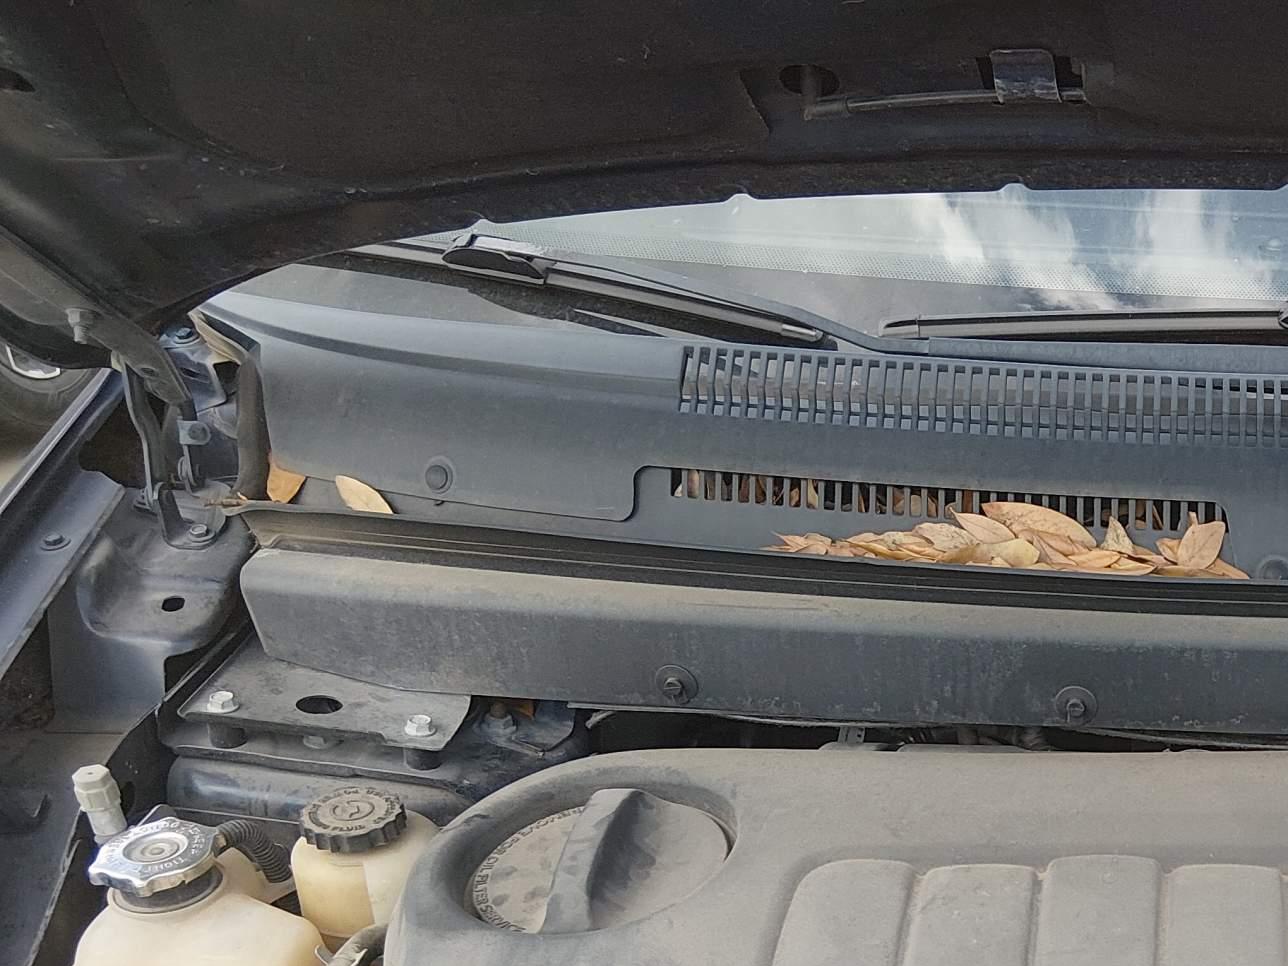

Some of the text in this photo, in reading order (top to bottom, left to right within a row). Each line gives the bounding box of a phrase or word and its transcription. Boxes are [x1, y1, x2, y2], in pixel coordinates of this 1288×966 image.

[495, 836, 520, 856] FOR
[480, 855, 499, 874] OIL
[473, 873, 490, 906] FILTER
